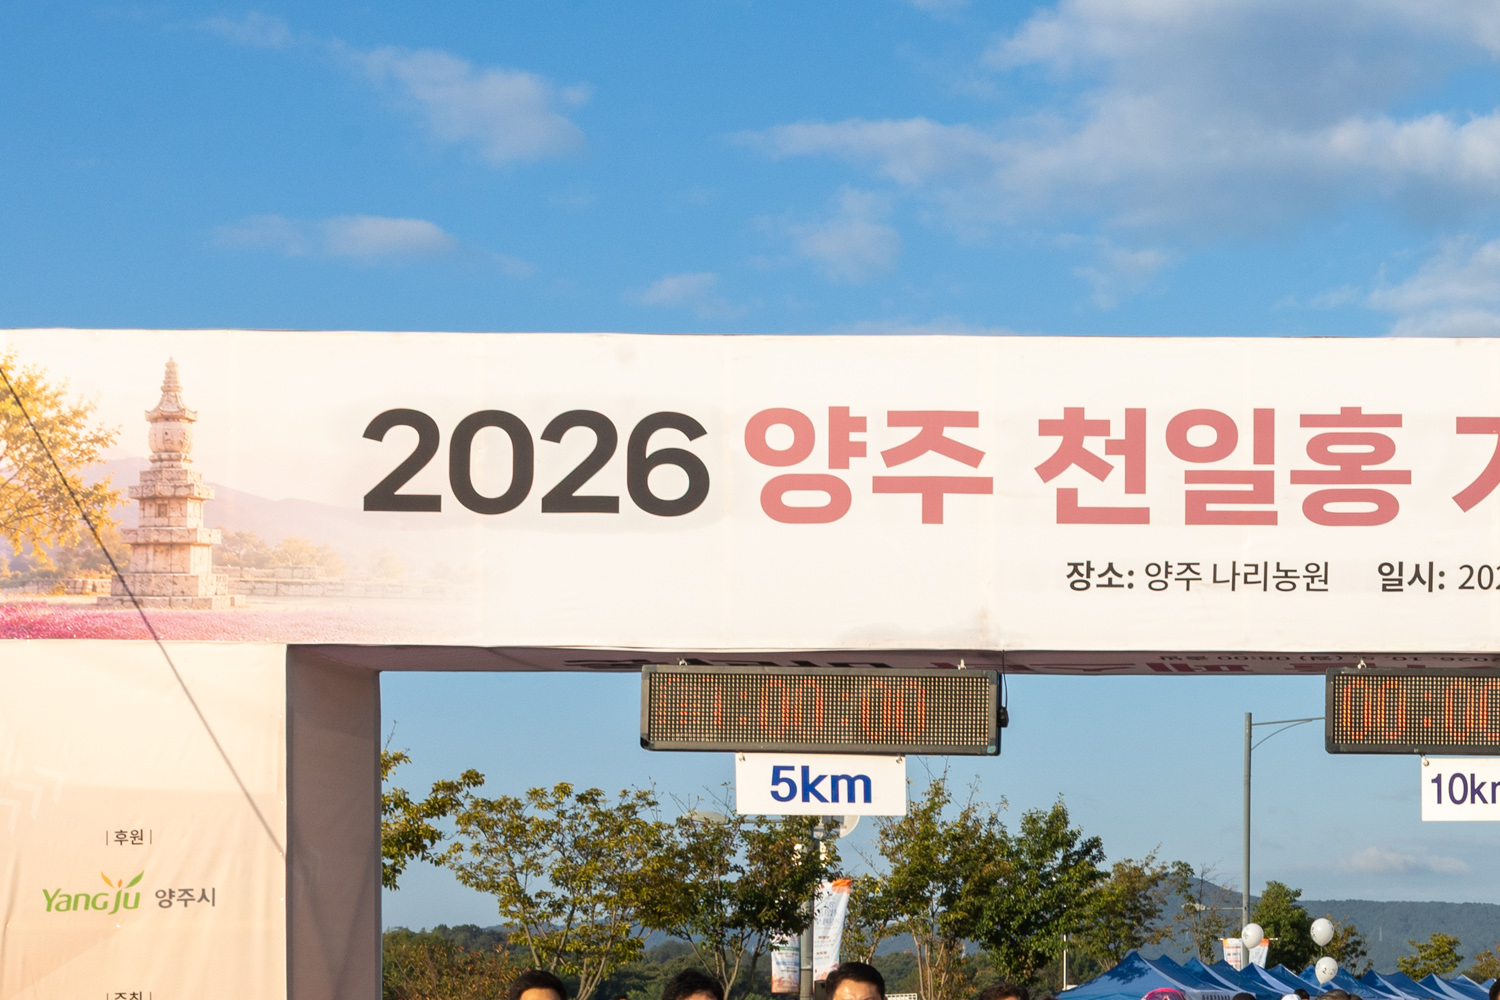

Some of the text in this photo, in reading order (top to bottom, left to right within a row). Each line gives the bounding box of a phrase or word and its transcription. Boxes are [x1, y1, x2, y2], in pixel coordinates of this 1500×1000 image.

[362, 408, 710, 517] 2026
[744, 405, 994, 525] 양주
[1034, 406, 1412, 527] 천일홍
[1066, 560, 1329, 592] 장소: 양주 나리농원
[1377, 561, 1446, 593] 일시:
[769, 764, 872, 804] 5km
[114, 828, 144, 846] 후원
[155, 887, 216, 909] 양주시
